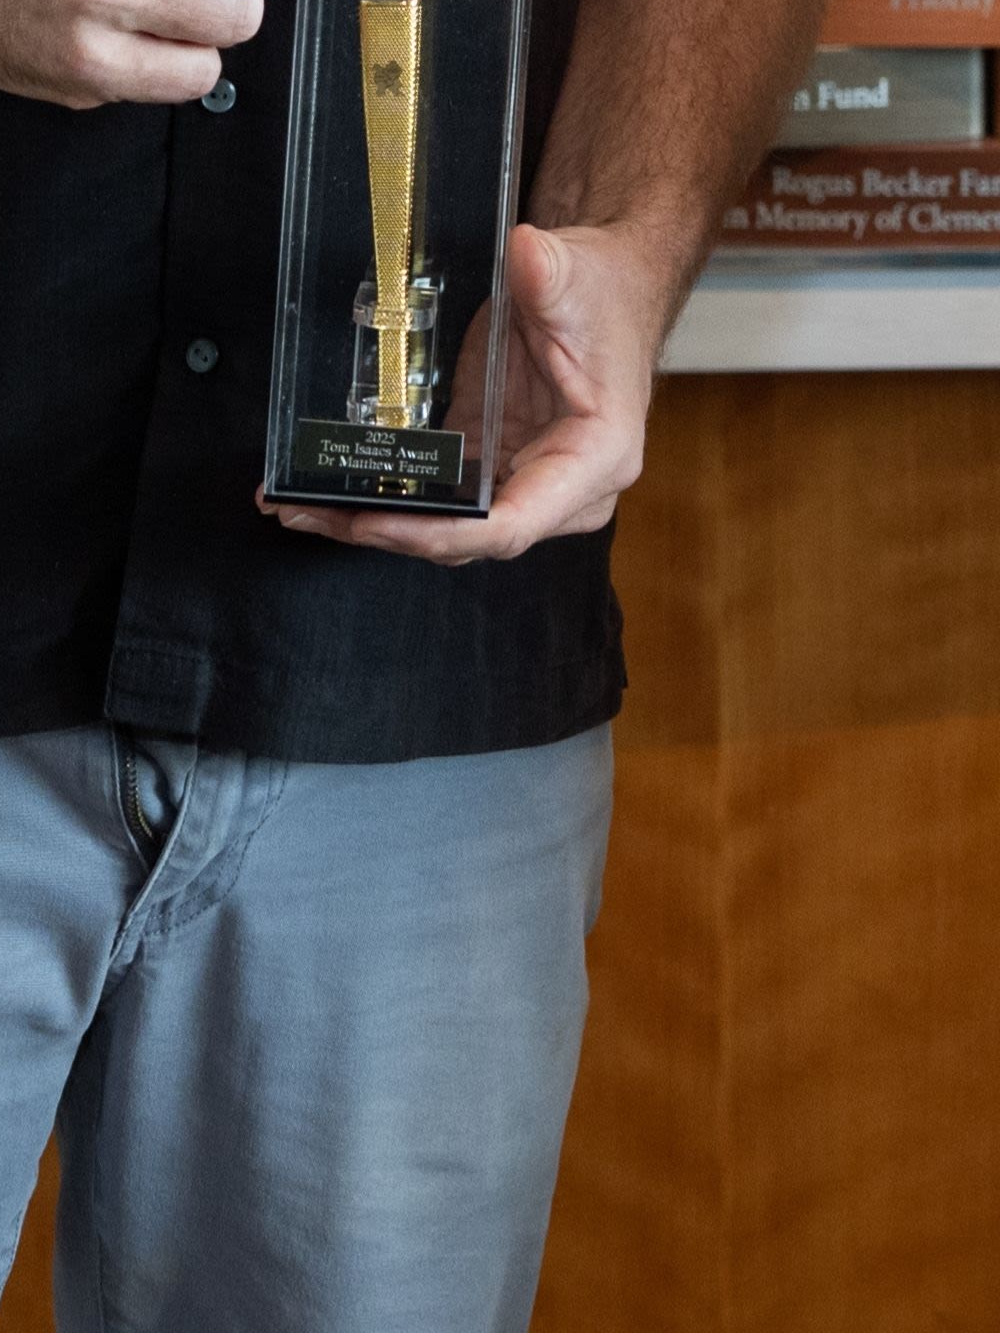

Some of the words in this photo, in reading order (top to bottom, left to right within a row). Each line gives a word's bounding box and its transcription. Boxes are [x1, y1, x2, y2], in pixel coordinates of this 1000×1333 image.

[817, 76, 890, 111] Fund
[861, 167, 952, 198] Becker
[755, 200, 869, 240] Memory
[874, 200, 907, 232] of
[320, 439, 350, 453] Tom
[355, 442, 392, 457] Isaacs
[396, 446, 439, 462] Award
[365, 431, 396, 445] 2025
[318, 453, 336, 467] Dr
[339, 455, 393, 471] Matthew
[400, 461, 440, 476] Farrer
